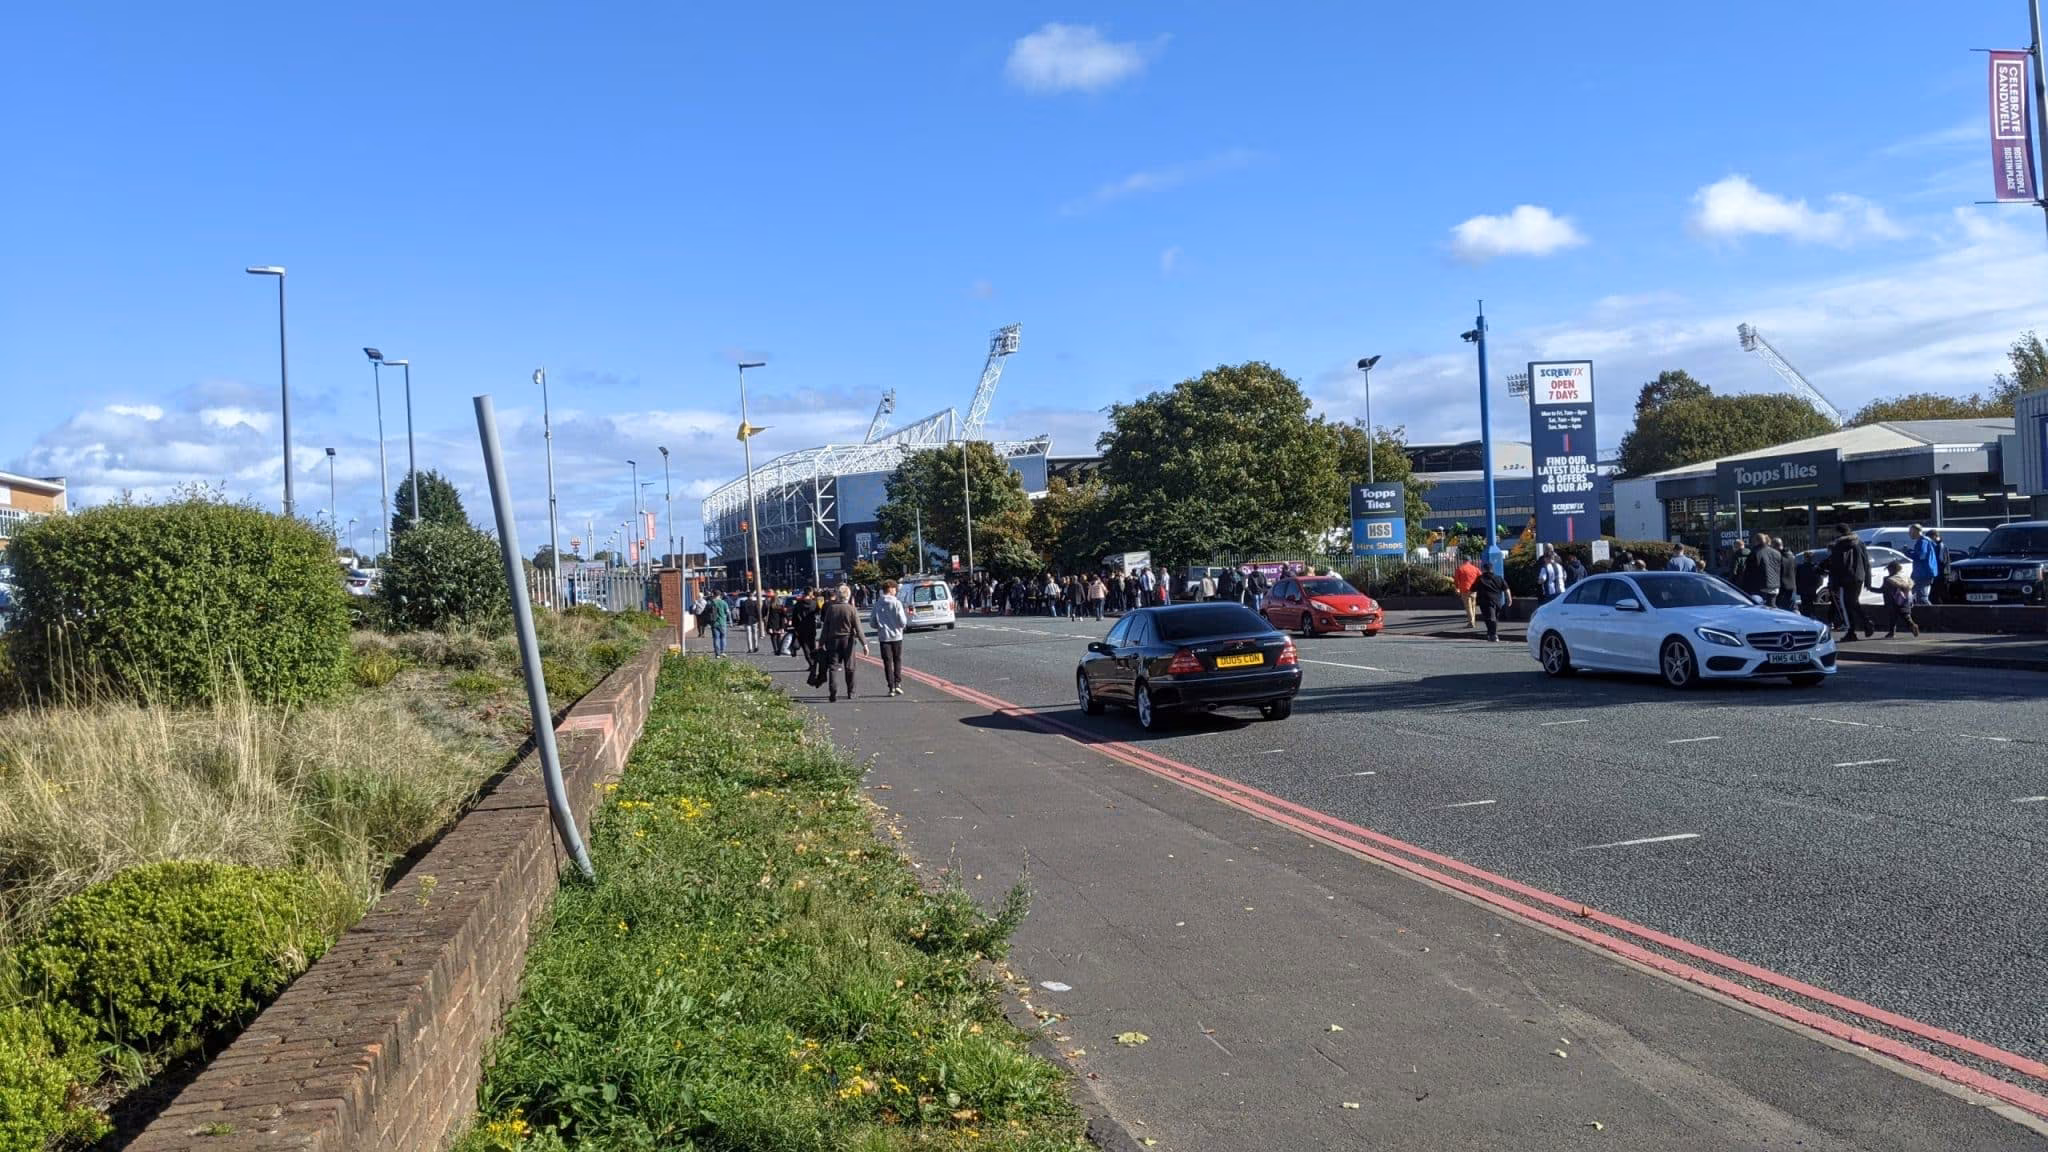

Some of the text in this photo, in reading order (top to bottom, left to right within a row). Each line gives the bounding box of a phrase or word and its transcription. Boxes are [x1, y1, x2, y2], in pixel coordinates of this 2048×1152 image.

[1999, 66, 2009, 132] SANDWELL
[2009, 67, 2021, 132] CELEBRATE
[2006, 170, 2016, 190] PLACE
[2015, 170, 2025, 193] PEOPLE
[1540, 368, 1584, 377] SCREWFIX
[1551, 379, 1575, 389] OPEN
[1548, 390, 1579, 400] 7 DAYS
[1546, 455, 1586, 466] FIND OUR
[1538, 464, 1596, 475] LATEST DEALS
[1734, 462, 1818, 486] Topps Tiles
[1547, 474, 1587, 484] & OFFERS
[1542, 482, 1593, 493] ON OUR APP
[1360, 488, 1396, 499] Topps
[1365, 500, 1391, 509] Tiles
[1369, 524, 1391, 536] HSS
[1376, 542, 1404, 550] Shops
